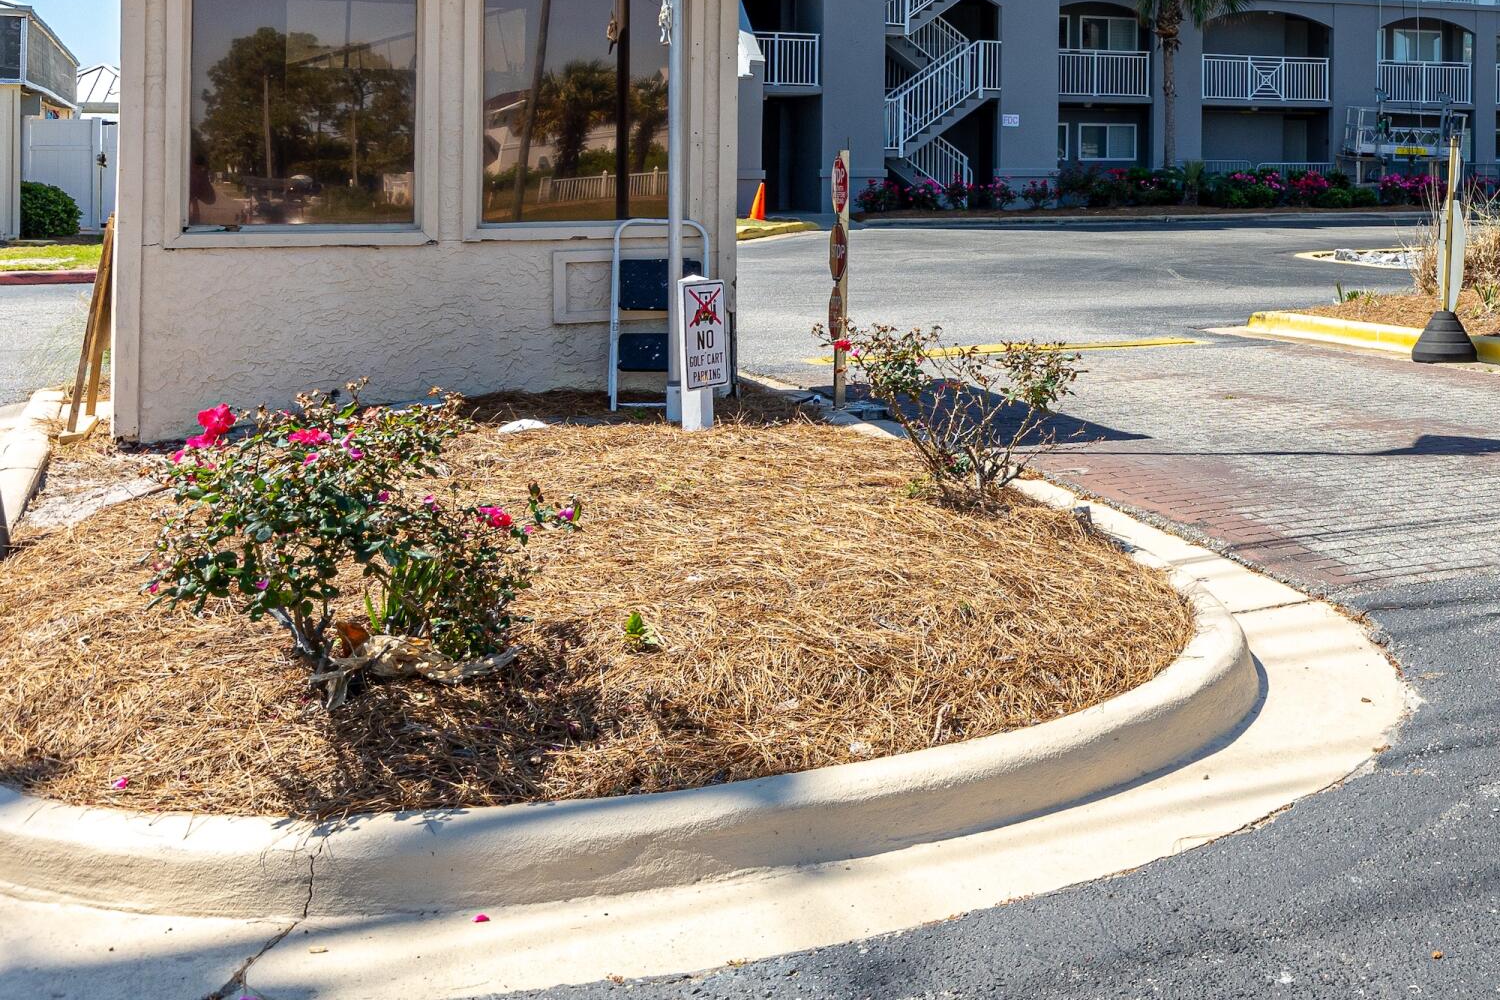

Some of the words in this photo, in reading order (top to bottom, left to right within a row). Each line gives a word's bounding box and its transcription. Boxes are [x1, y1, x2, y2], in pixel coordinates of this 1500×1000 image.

[697, 330, 714, 350] NO
[690, 355, 704, 367] GOLF
[706, 352, 723, 365] CART
[693, 368, 720, 383] PARKING
